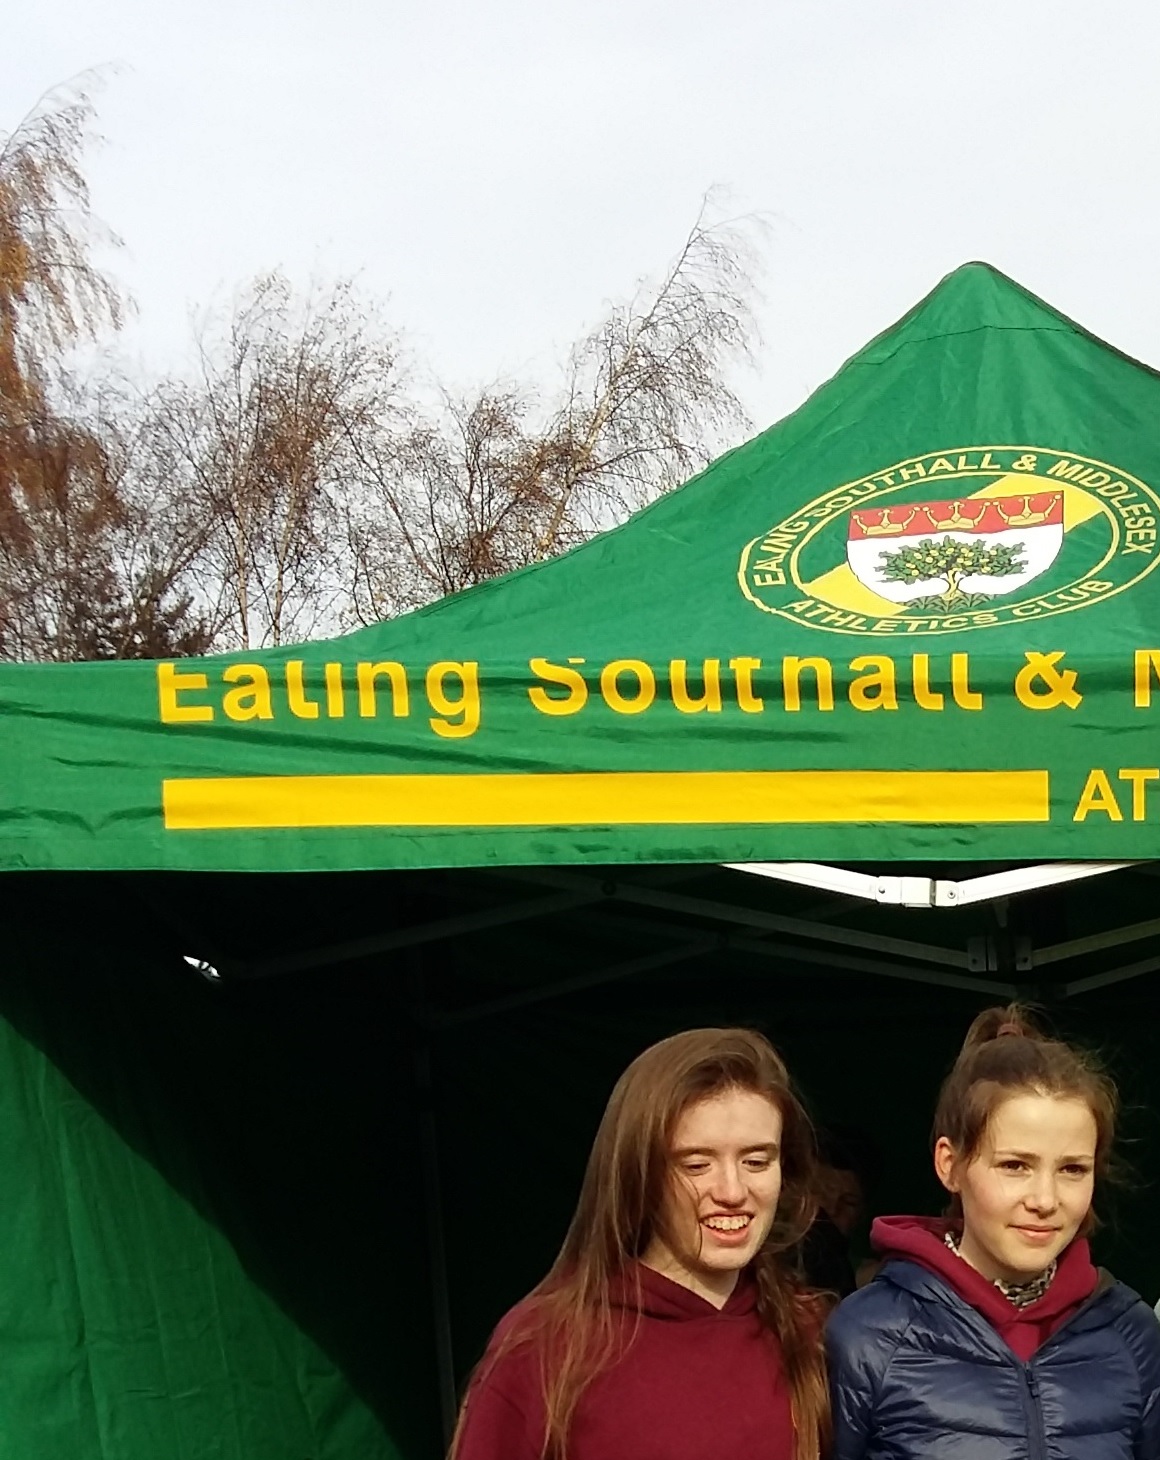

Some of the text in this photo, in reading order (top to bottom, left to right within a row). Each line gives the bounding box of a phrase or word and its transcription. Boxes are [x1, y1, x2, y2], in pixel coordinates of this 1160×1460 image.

[753, 453, 1157, 586] EALING SOUTHALL & MIDDLESEX
[786, 579, 1114, 633] ATHLETICS CLUB
[157, 660, 481, 738] Ealing
[527, 652, 983, 716] Southall
[1014, 651, 1083, 710] &
